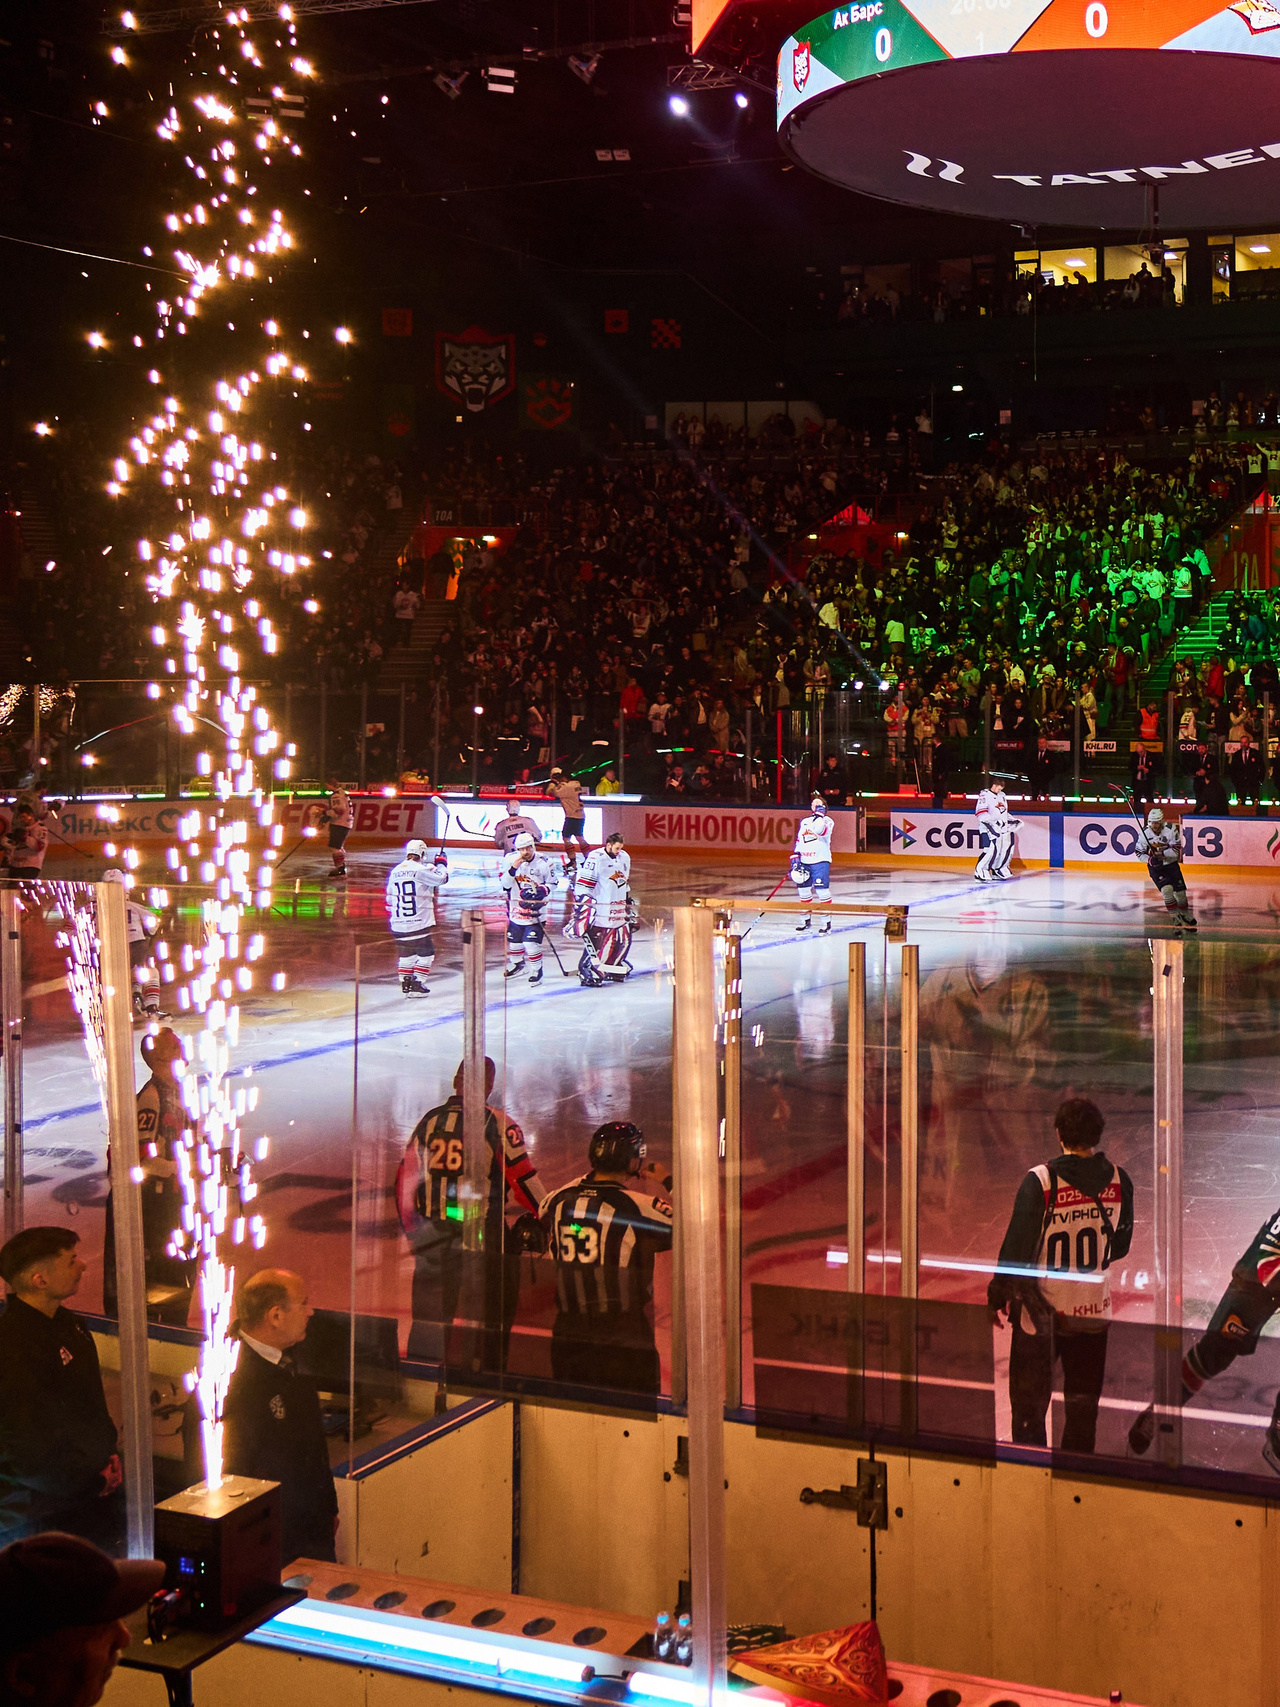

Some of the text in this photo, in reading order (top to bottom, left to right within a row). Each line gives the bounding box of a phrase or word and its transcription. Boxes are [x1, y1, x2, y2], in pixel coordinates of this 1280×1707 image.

[833, 1, 884, 29] Ак Барс
[1085, 3, 1109, 38] 0
[874, 27, 893, 62] 0
[1085, 743, 1115, 751] KHL.RU
[129, 785, 164, 793] KHL.RU
[403, 784, 432, 792] FONBET
[480, 786, 508, 794] FONBET
[515, 786, 544, 794] FONBET
[281, 803, 424, 832] FOBET
[645, 812, 799, 846] КИНОПОИС
[394, 880, 418, 918] 19
[138, 1111, 156, 1130] 27
[428, 1137, 464, 1173] 26
[558, 1224, 602, 1264] 53
